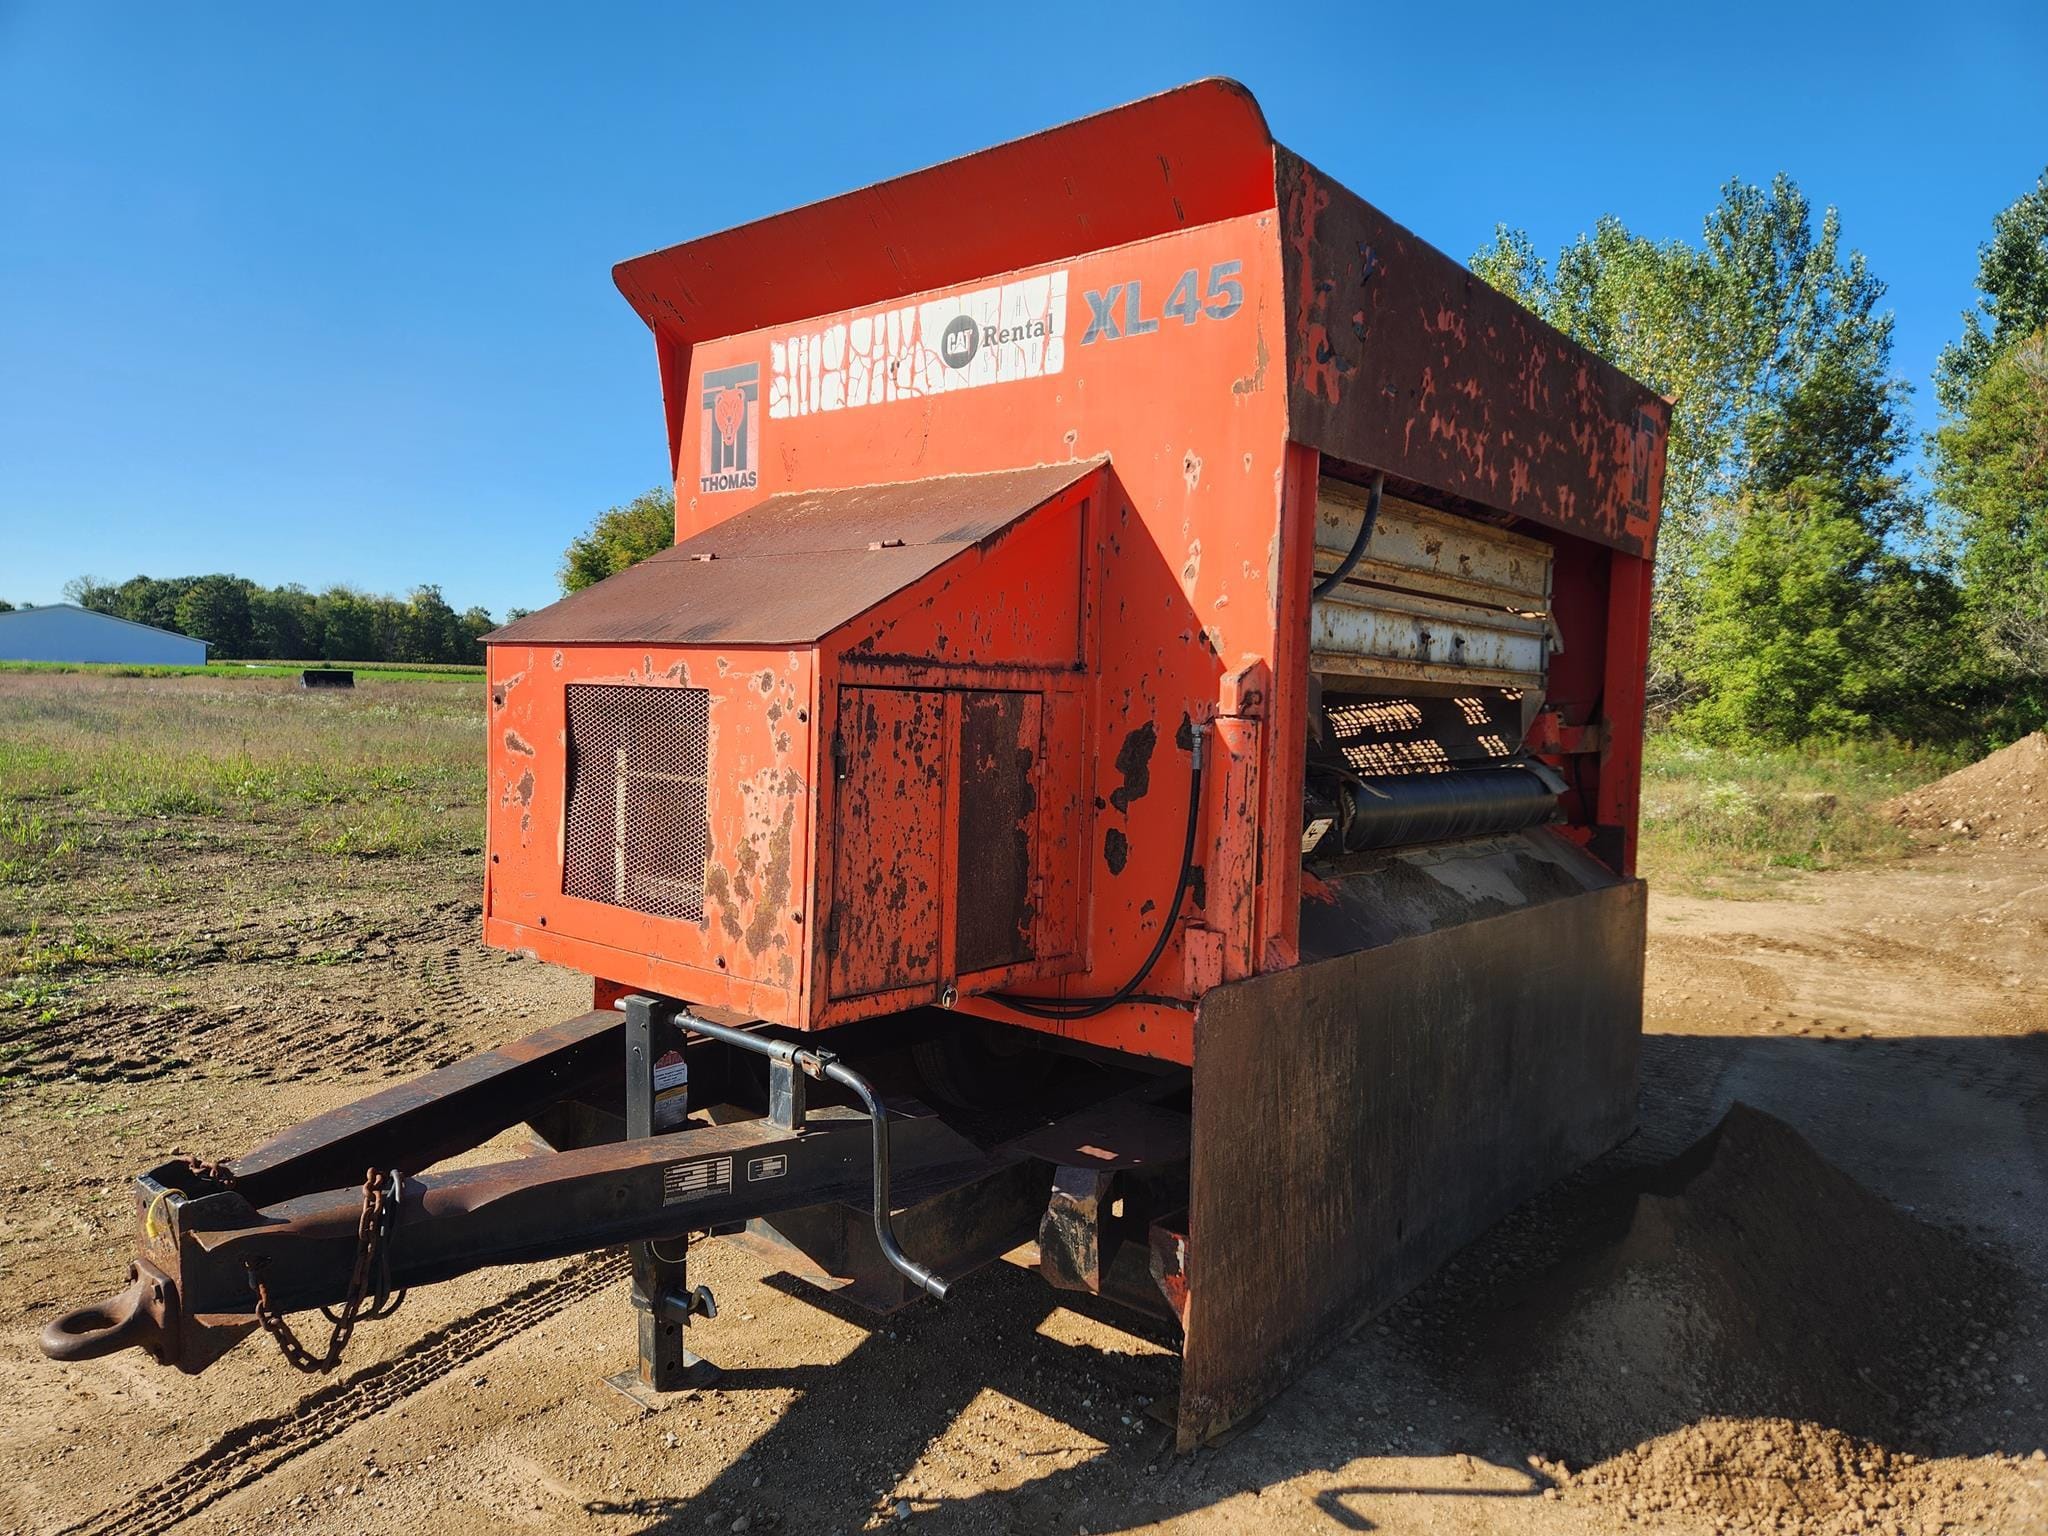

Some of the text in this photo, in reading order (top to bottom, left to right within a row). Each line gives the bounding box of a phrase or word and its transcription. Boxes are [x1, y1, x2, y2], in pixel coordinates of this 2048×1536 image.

[1080, 259, 1244, 346] XL 45
[946, 313, 1054, 355] CAT Rental
[701, 471, 757, 492] THOMAS
